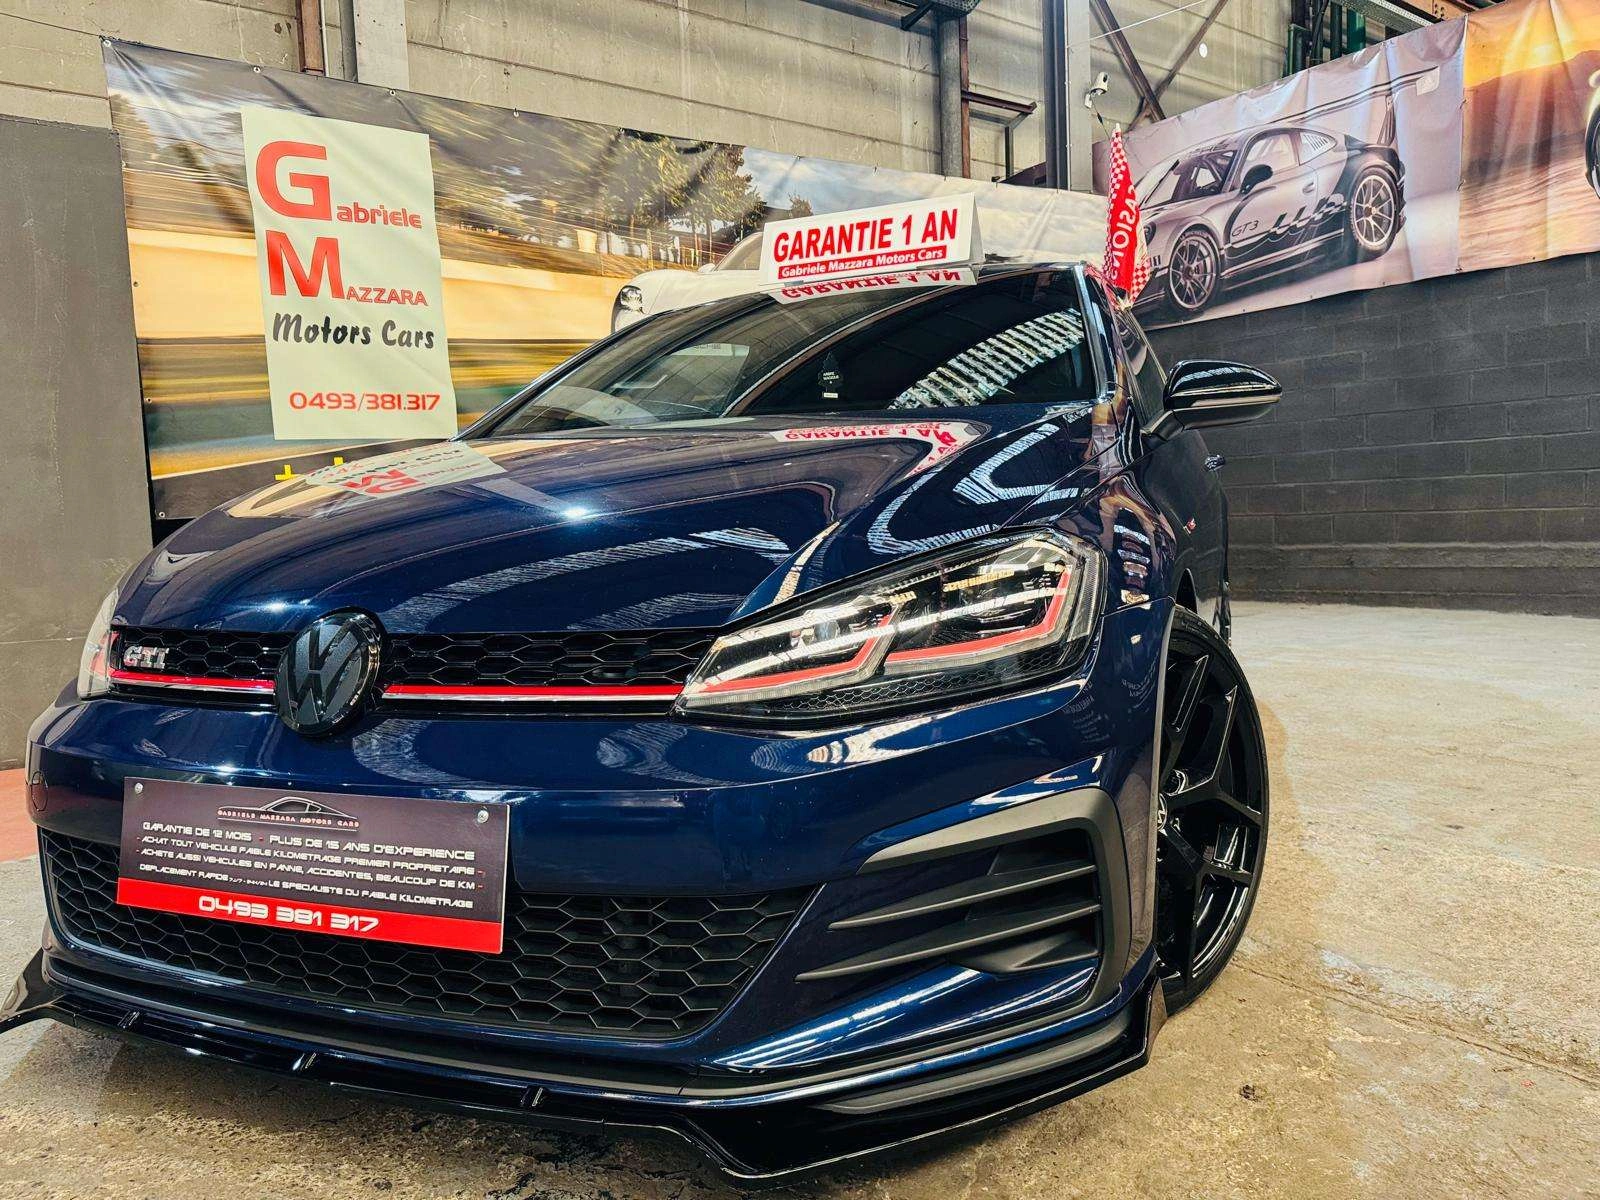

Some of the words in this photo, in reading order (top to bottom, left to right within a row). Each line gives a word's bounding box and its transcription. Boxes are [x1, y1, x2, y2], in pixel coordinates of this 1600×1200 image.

[774, 217, 893, 263] GARANTIE
[902, 214, 913, 245] 1
[921, 208, 958, 243] AN
[1232, 220, 1260, 237] GT3
[781, 264, 826, 278] Gabriele
[828, 259, 873, 272] Mazzara
[875, 253, 915, 266] Motors
[917, 249, 943, 261] Cars
[272, 312, 371, 345] Motors
[381, 319, 434, 349] Cars
[289, 391, 441, 411] 0493/381.317
[123, 645, 170, 669] GTI
[142, 821, 193, 836] GARANTIE
[195, 827, 210, 837] DE
[212, 829, 223, 839] 12
[225, 831, 252, 842] MOIS
[269, 835, 302, 847] PLUS
[305, 838, 323, 849] DE
[326, 840, 340, 850] 15
[343, 842, 370, 853] ANS
[374, 844, 475, 861] D'EXPERIENCE
[142, 836, 169, 846] ACHAT
[171, 838, 193, 848] TOUT
[196, 842, 237, 854] VEHICULE
[273, 849, 341, 864] KILOMETRAGE
[344, 857, 390, 869] PREMIER
[393, 861, 475, 876] PROPRIETAIRE
[139, 863, 197, 877] DEPLACEMENT
[199, 870, 229, 882] RAPIDE
[268, 880, 280, 888] LE
[282, 881, 343, 895] SPECIALISTE
[345, 889, 360, 897] DU
[400, 893, 474, 909] KILOMETRAGE
[141, 848, 174, 859] ACHETE
[176, 852, 201, 862] AUSSI
[203, 856, 252, 868] VEHICULES
[254, 861, 268, 870] EN
[376, 874, 437, 886] BEAUCOUP
[439, 879, 456, 888] DE
[458, 880, 475, 890] KM
[199, 895, 269, 920] 0493
[276, 905, 323, 926] 381
[330, 913, 379, 932] 317
